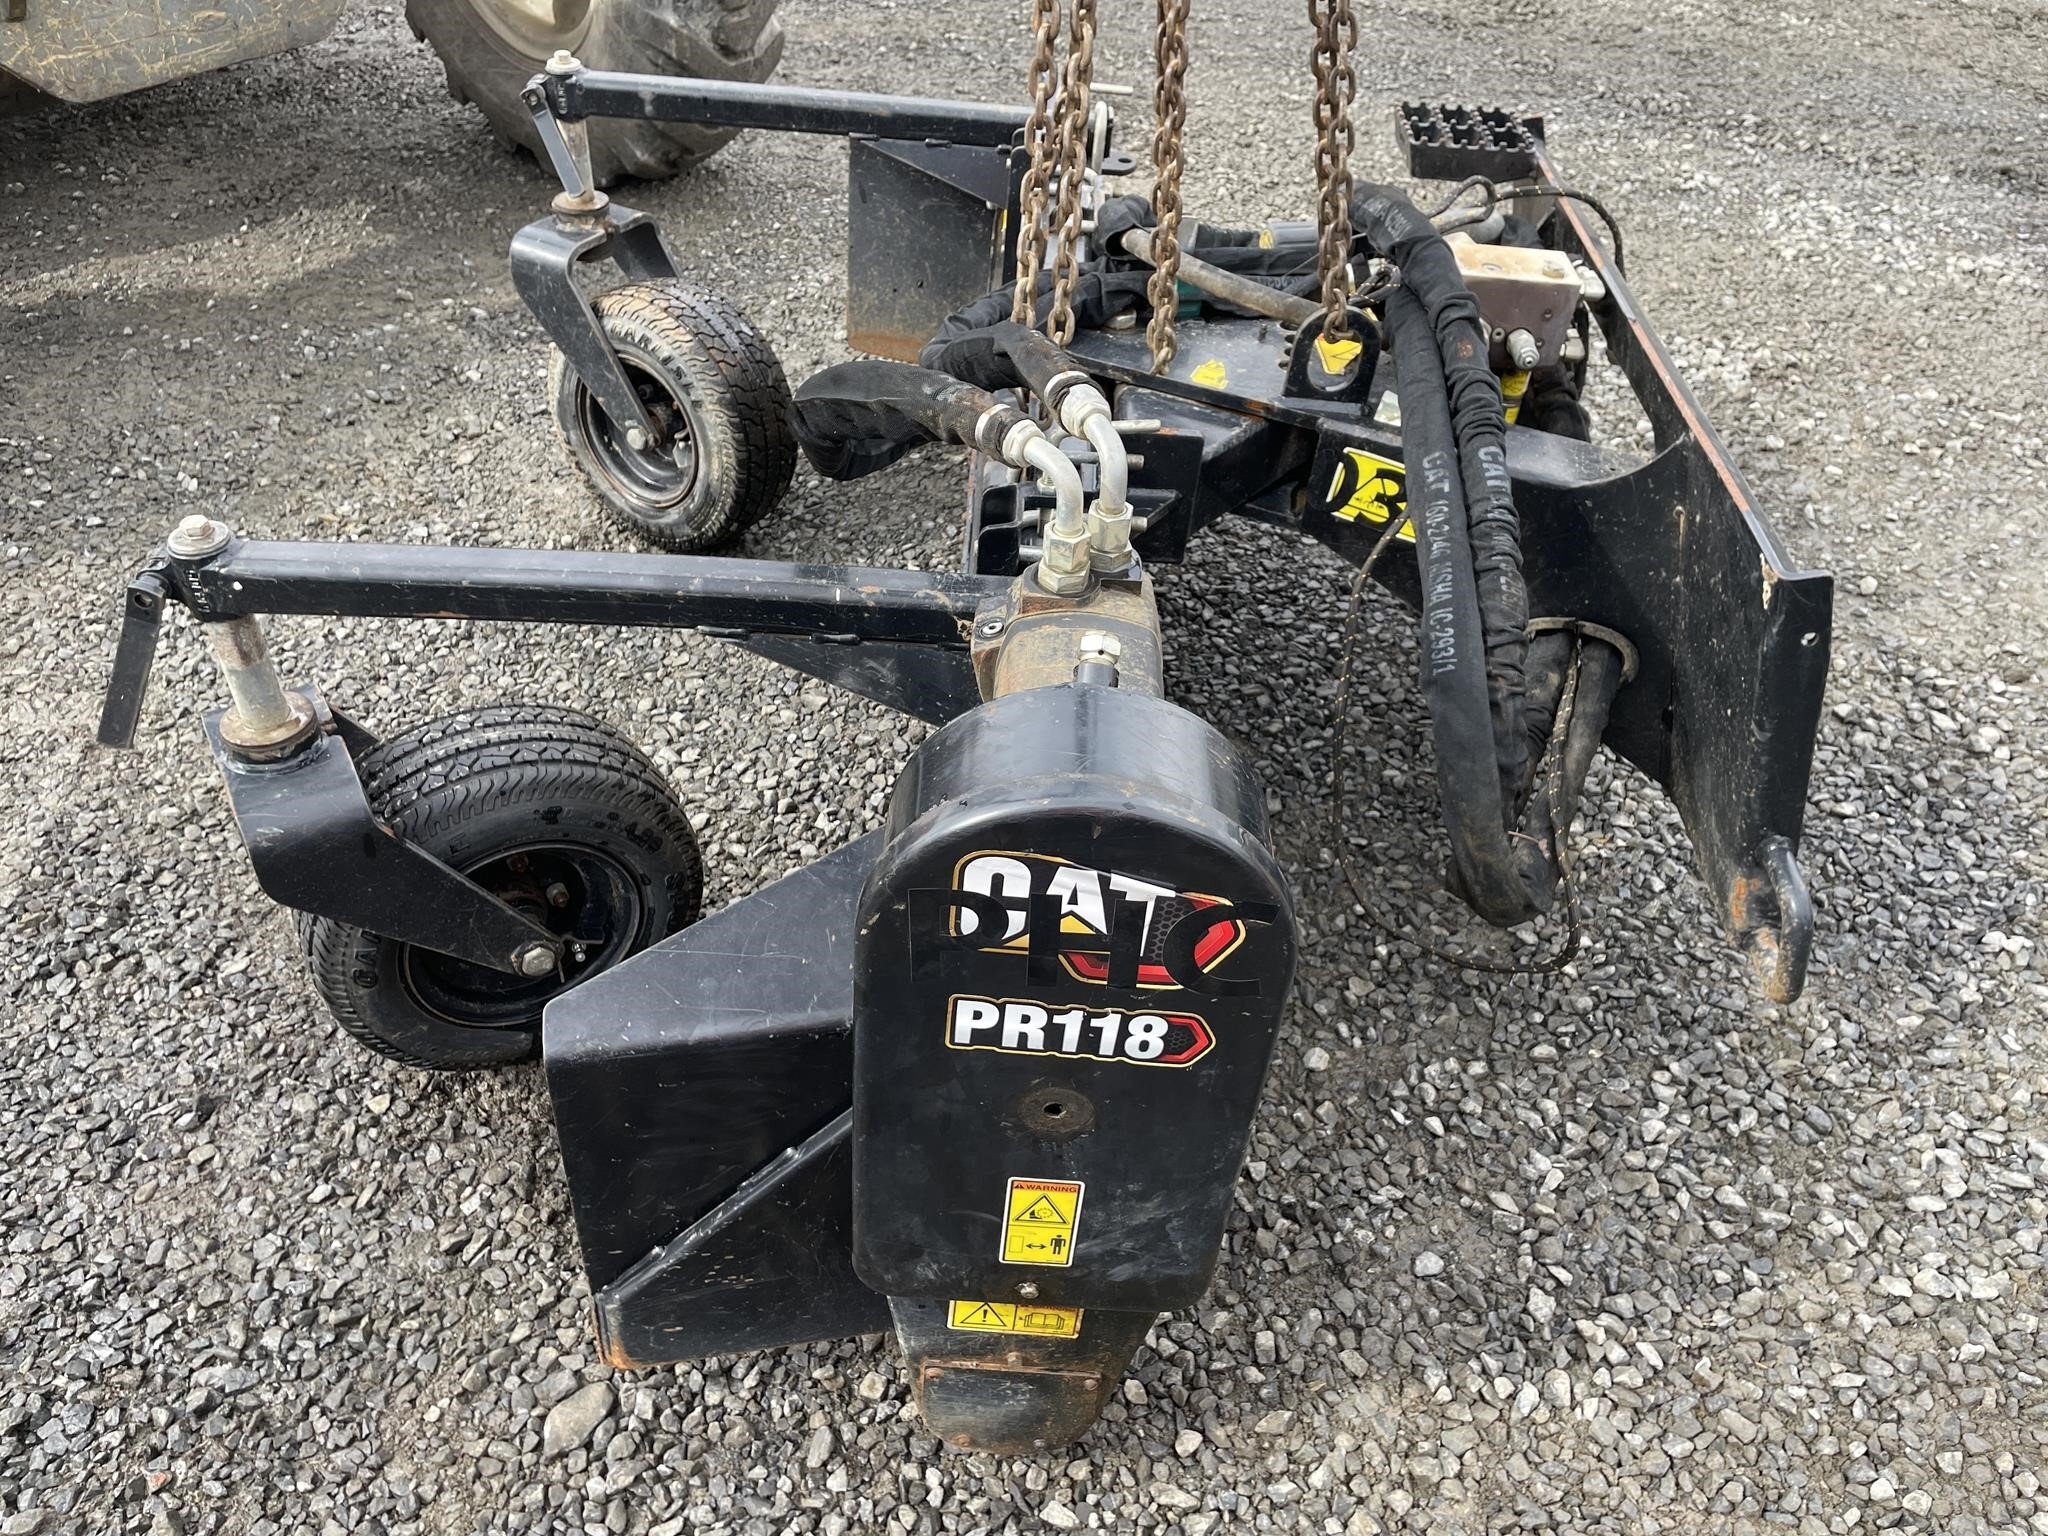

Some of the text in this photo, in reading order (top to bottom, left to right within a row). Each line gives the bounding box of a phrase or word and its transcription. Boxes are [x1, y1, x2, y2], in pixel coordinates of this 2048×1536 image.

[1422, 451, 1450, 493] CAT
[960, 856, 1176, 957] CAT
[953, 999, 1169, 1060] PR118
[1025, 1183, 1078, 1194] WARNING
